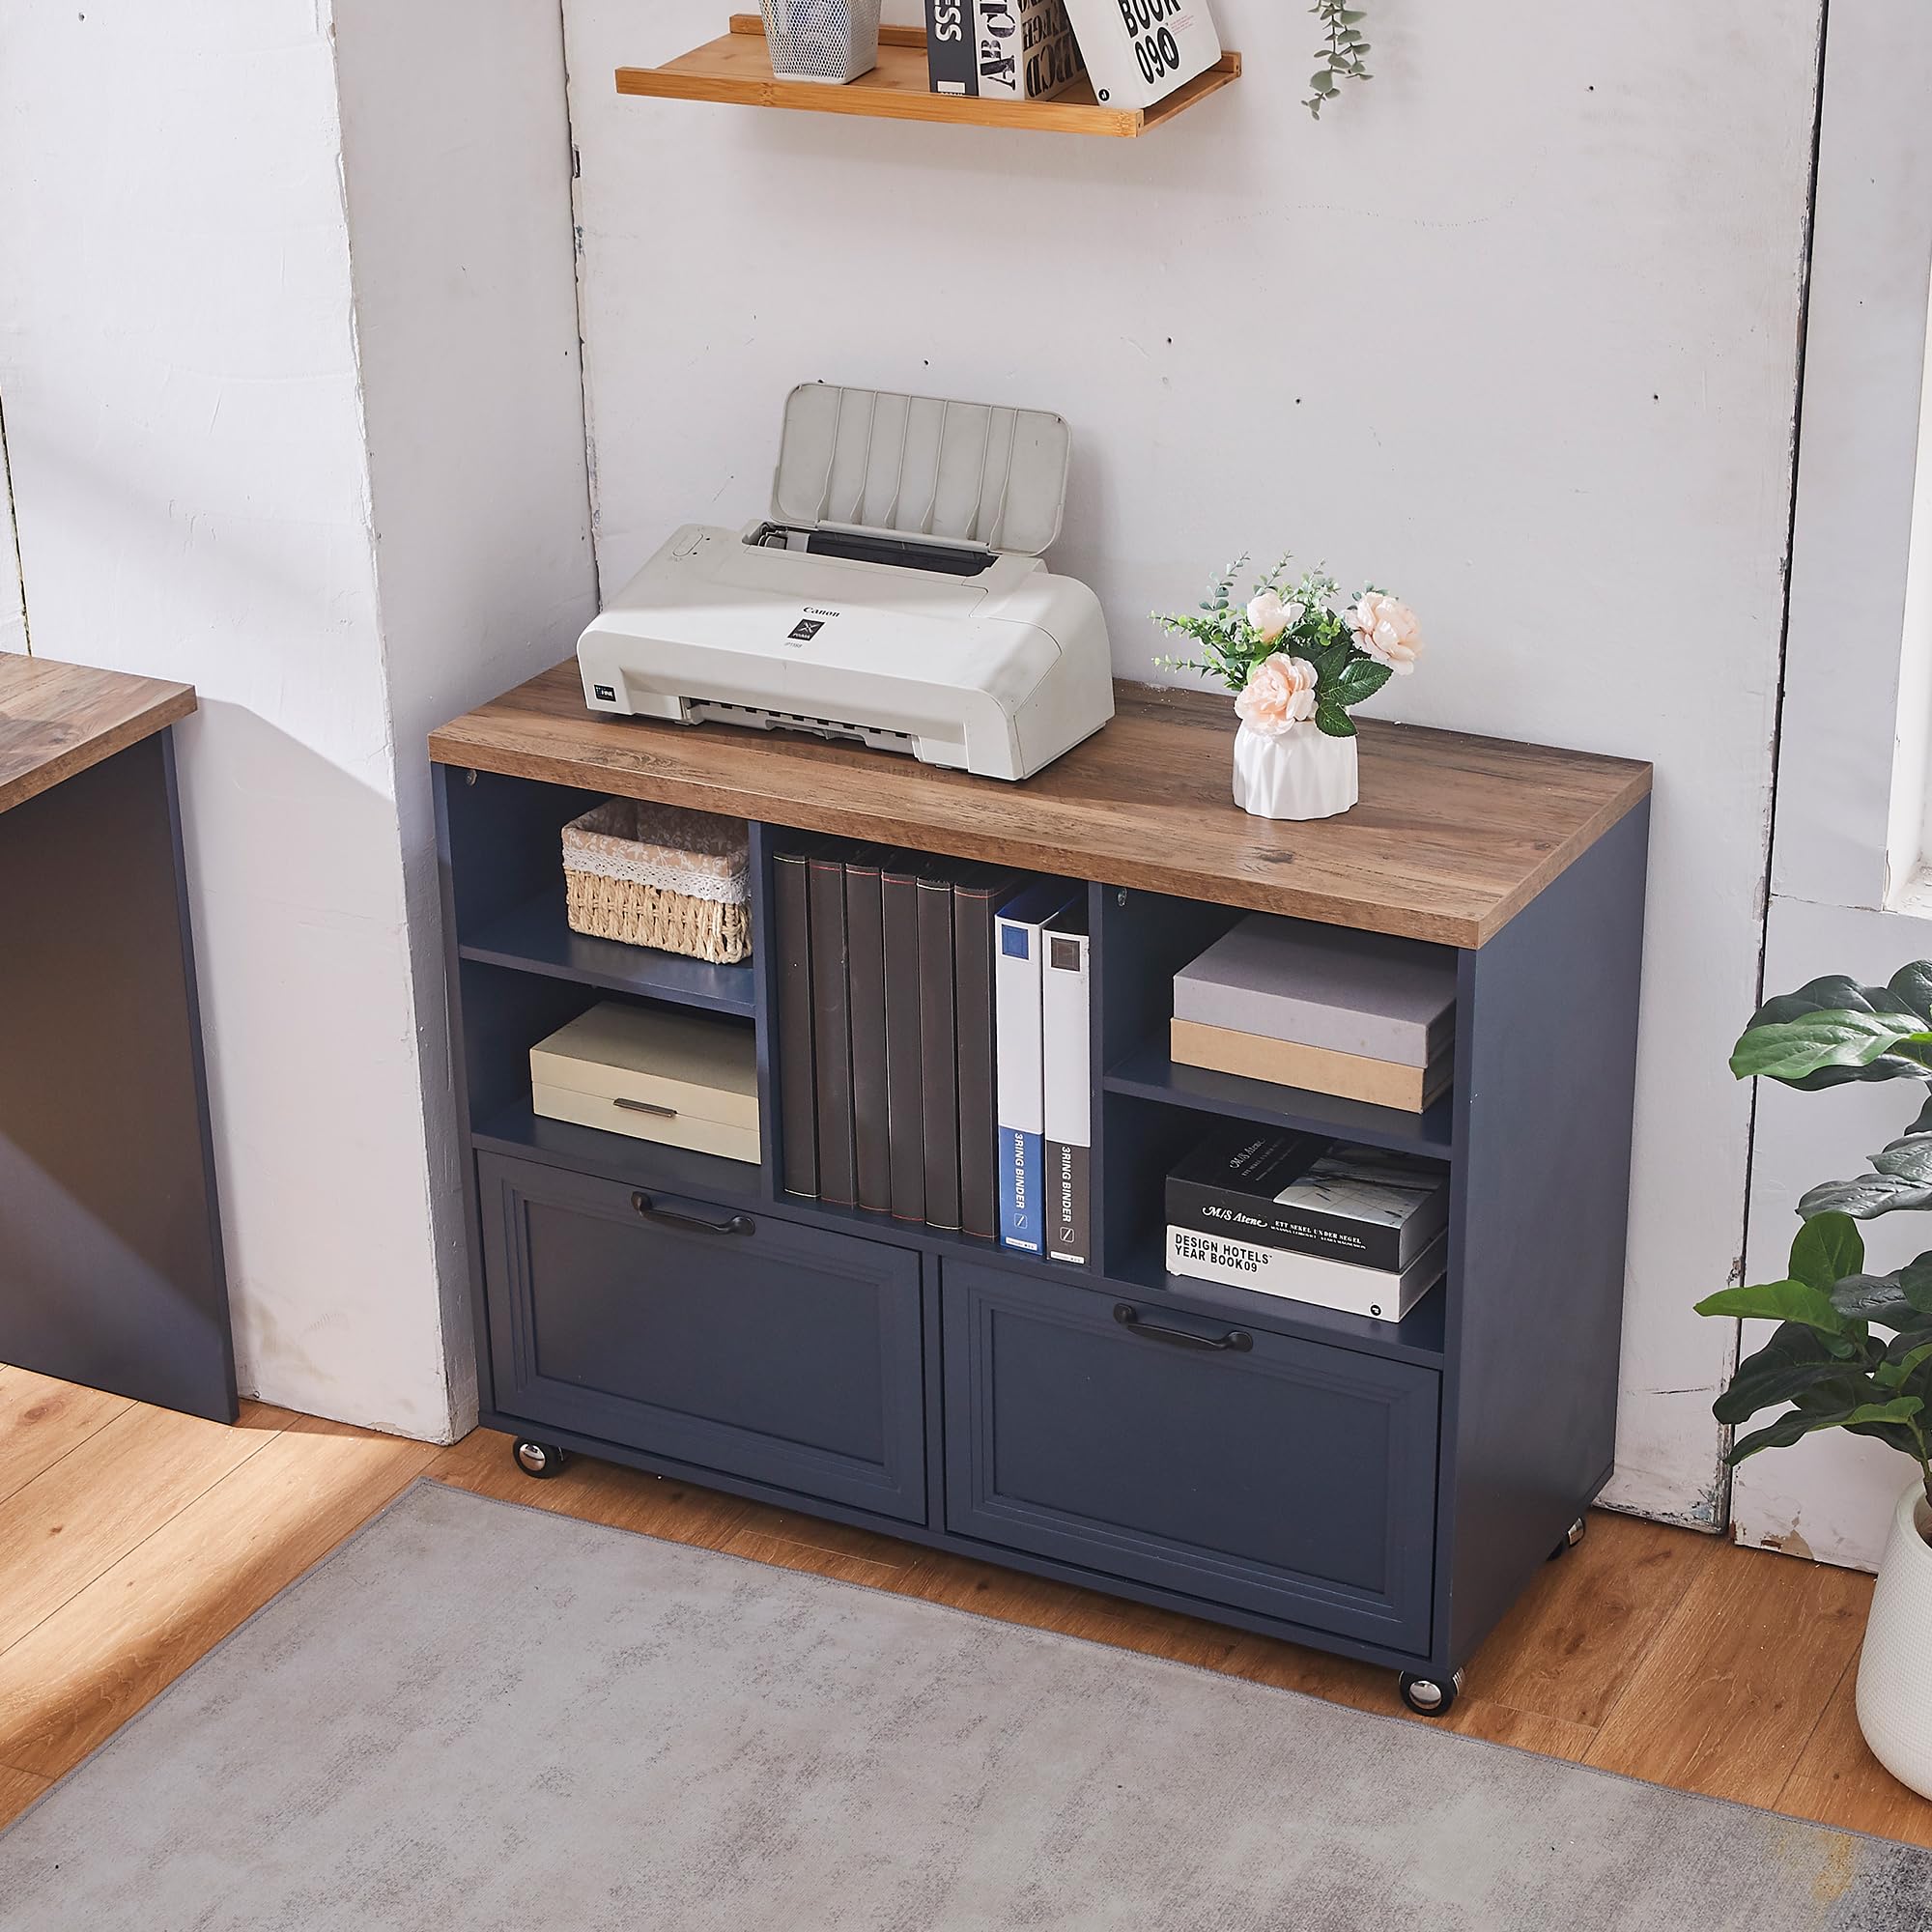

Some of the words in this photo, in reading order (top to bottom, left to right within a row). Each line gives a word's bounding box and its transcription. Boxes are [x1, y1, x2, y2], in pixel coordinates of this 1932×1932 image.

[803, 606, 840, 617] Canon
[1014, 1132, 1024, 1167] 3RING
[1062, 1146, 1071, 1180] 3RING
[1015, 1167, 1025, 1209] BINDER
[1062, 1180, 1071, 1222] BINDER
[1202, 1206, 1233, 1221] M/S
[1233, 1212, 1267, 1228] Atene
[1175, 1234, 1218, 1253] DESIGN
[1314, 1228, 1338, 1238] UNDER
[1175, 1244, 1206, 1262] YEAR
[1210, 1253, 1257, 1272] BOOK09
